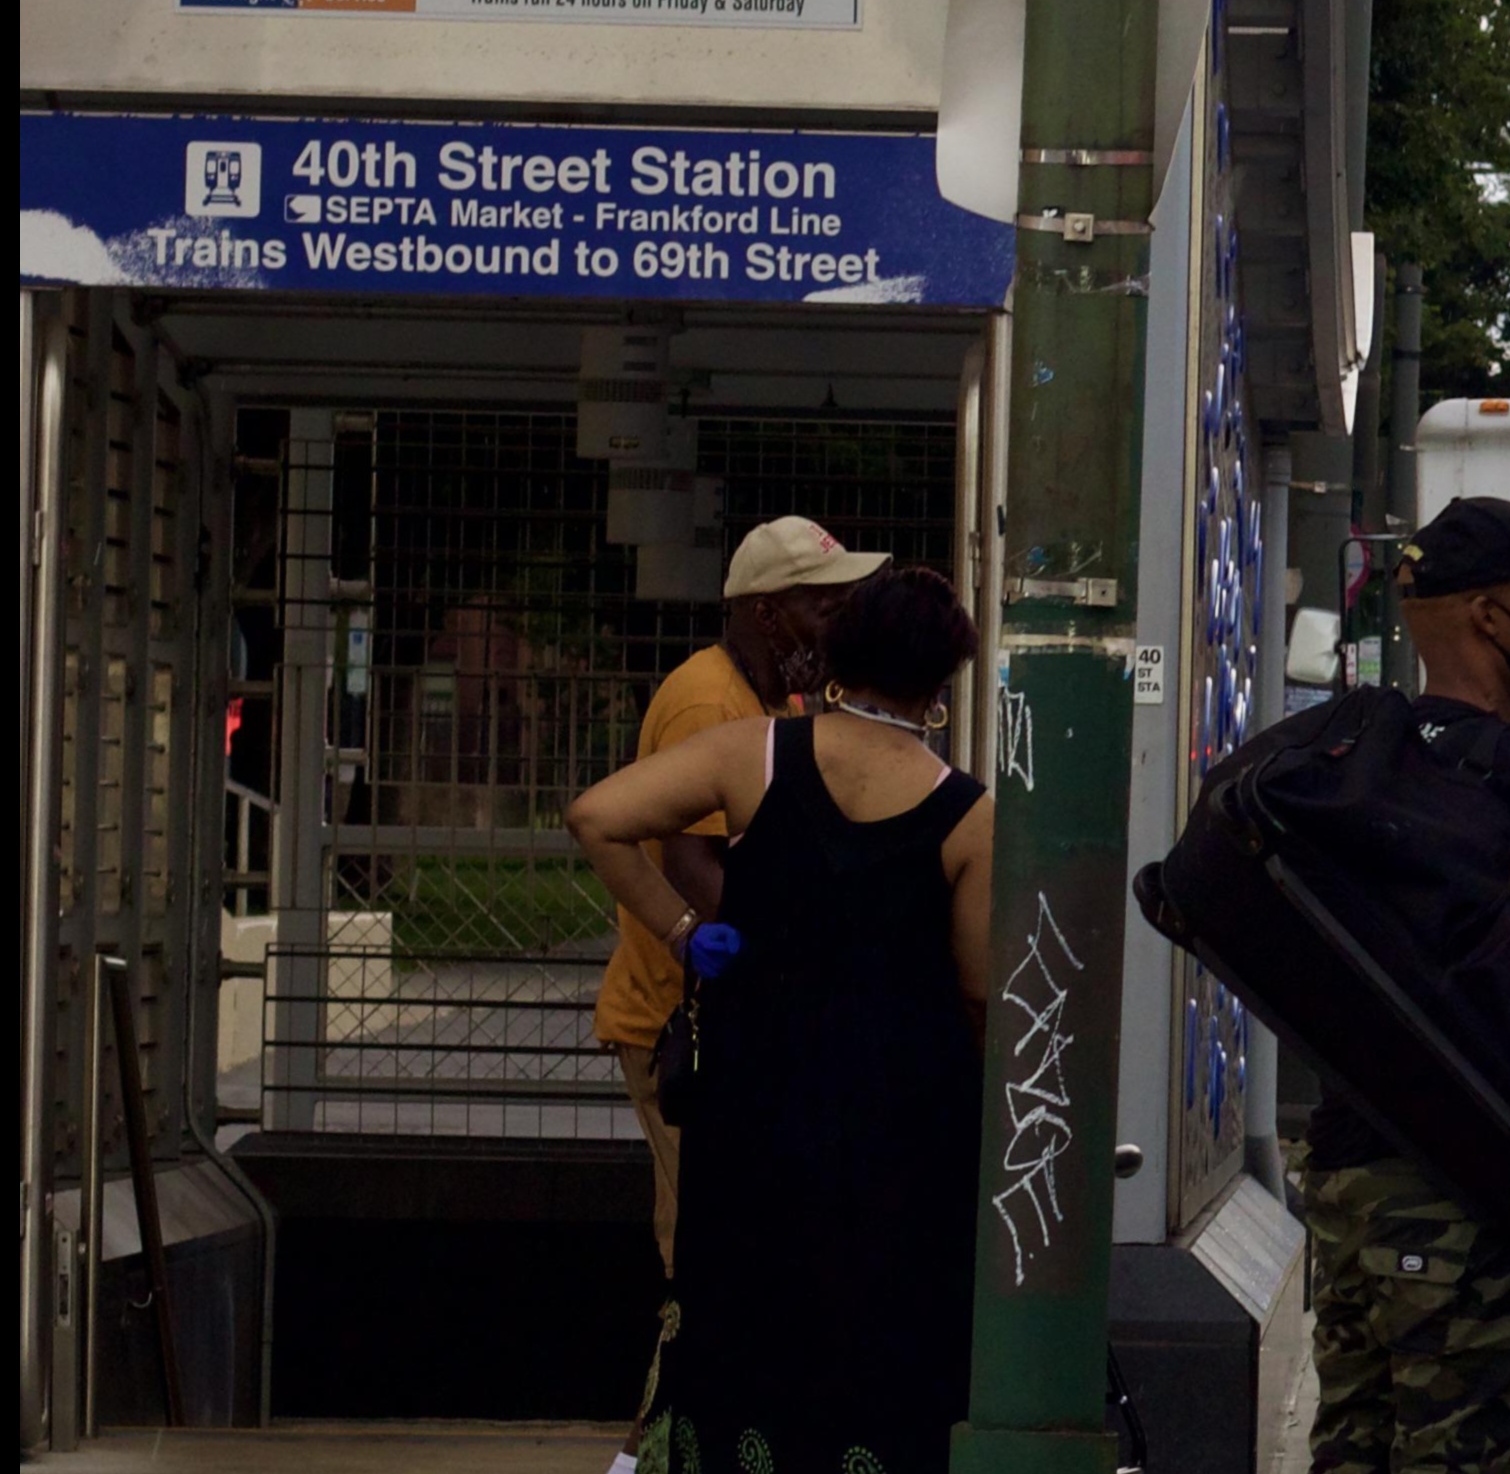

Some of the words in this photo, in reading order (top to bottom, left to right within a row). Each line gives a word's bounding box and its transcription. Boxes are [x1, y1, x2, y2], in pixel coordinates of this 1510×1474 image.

[292, 139, 417, 189] 40th
[438, 140, 611, 194] Street
[630, 145, 836, 199] Station
[325, 195, 437, 226] SEPTA
[450, 199, 563, 229] Market
[596, 202, 758, 234] Frankford
[770, 206, 841, 236] Line
[147, 227, 287, 269] Trains
[302, 231, 559, 274] Westbound
[574, 240, 619, 277] to
[633, 240, 729, 279] 69th
[745, 242, 880, 283] Street
[1138, 649, 1161, 664] 40
[1137, 682, 1161, 692] STA
[1138, 668, 1152, 678] ST
